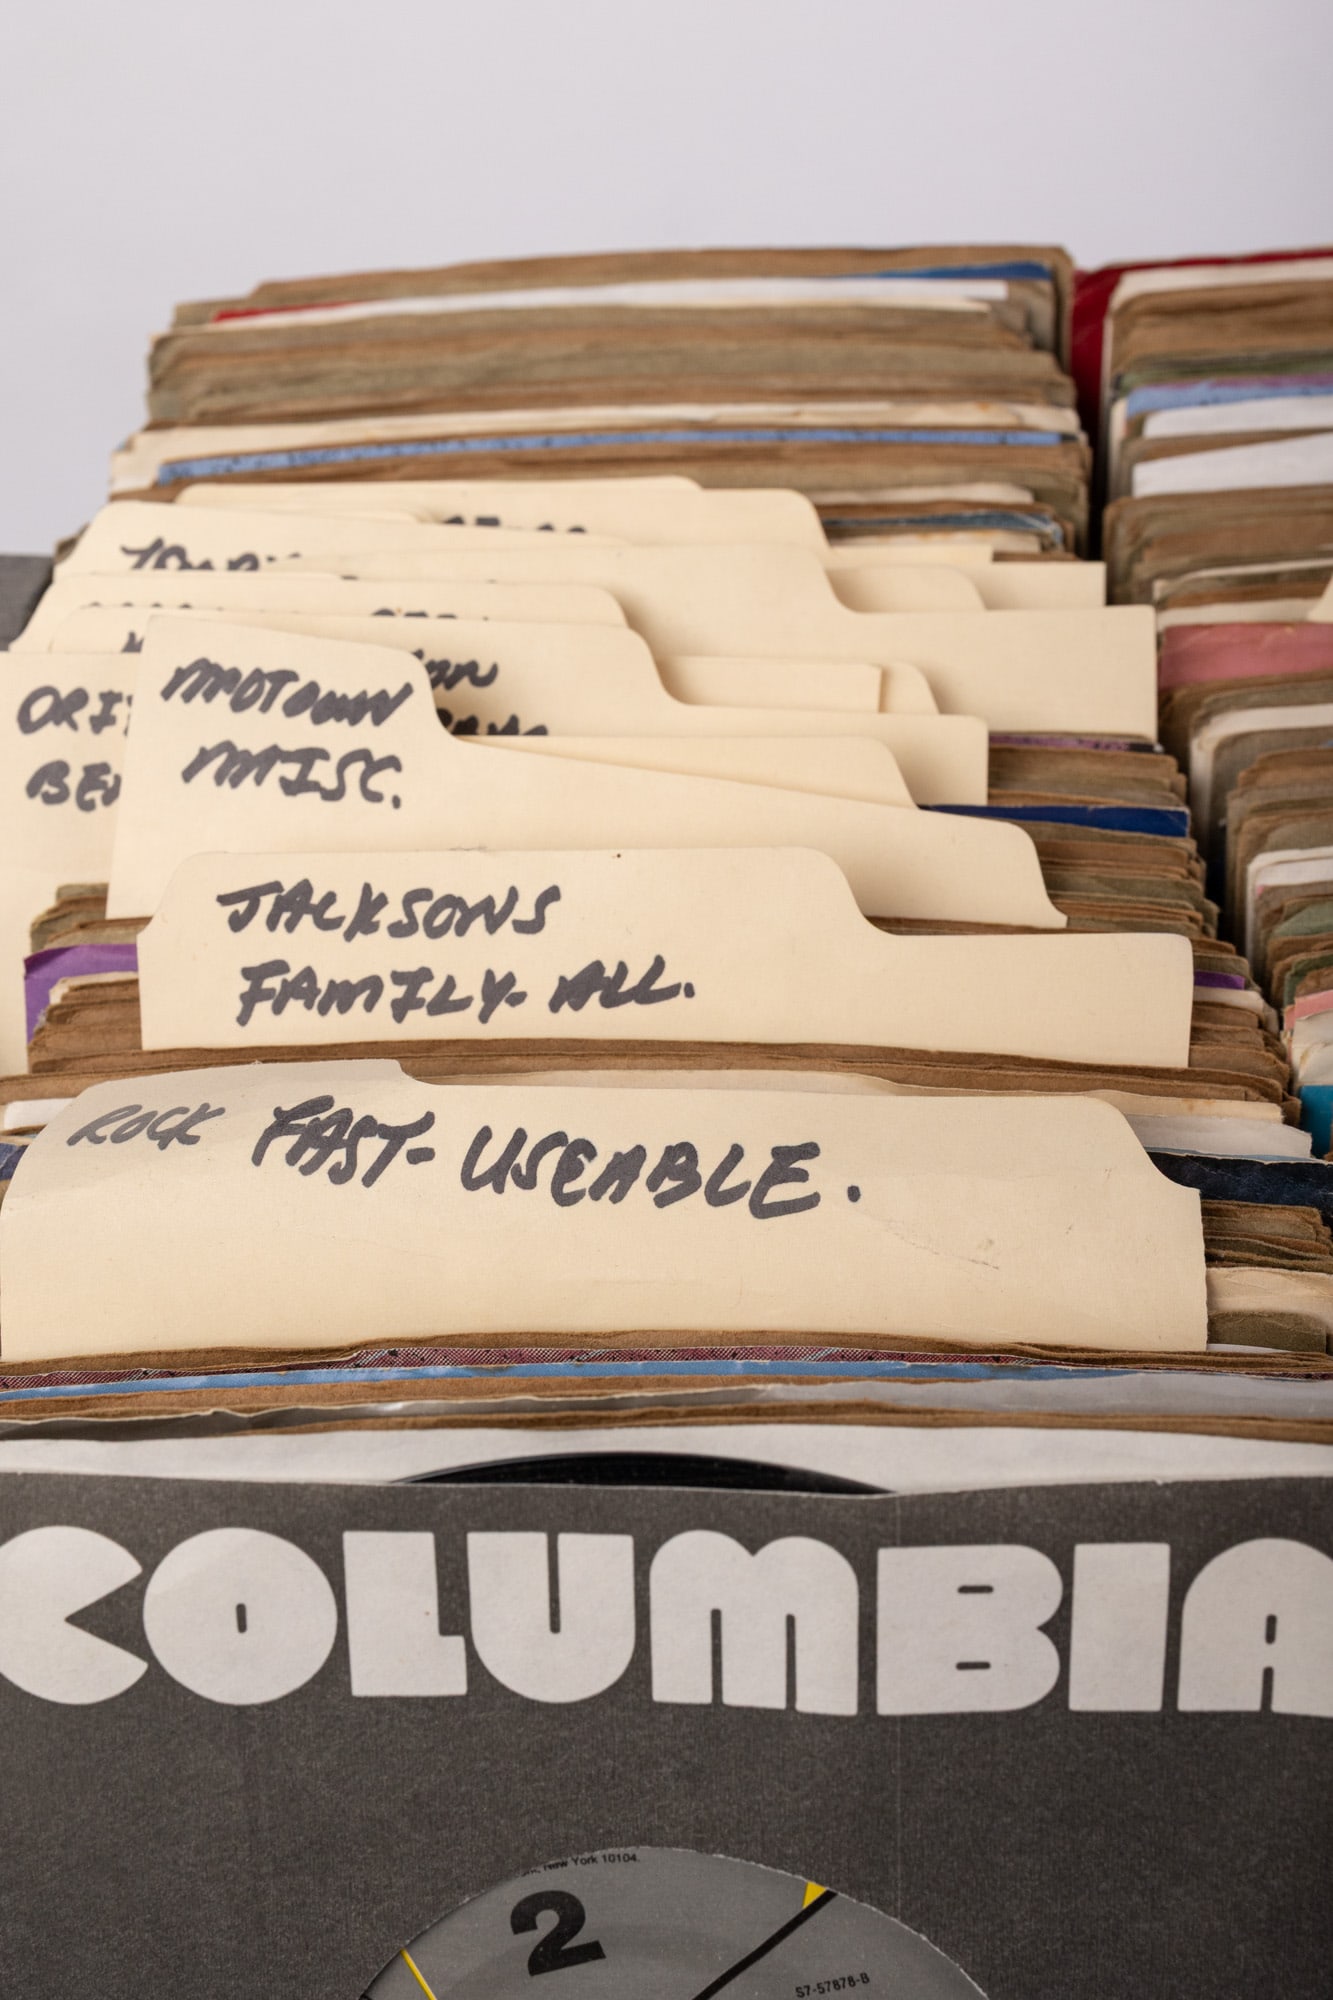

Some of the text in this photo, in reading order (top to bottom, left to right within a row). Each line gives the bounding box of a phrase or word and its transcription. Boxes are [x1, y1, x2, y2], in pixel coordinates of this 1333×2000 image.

[16, 685, 133, 736] ORI
[160, 656, 414, 726] MOTOWN
[181, 740, 403, 810] MISC.
[216, 879, 562, 942] JACKSONS
[547, 954, 697, 1013] ALL.
[66, 1102, 226, 1153] ROCK
[250, 1094, 436, 1189] FAST-
[0, 1524, 1333, 1718] COLUMBIA
[571, 1855, 598, 1866] York
[509, 1889, 608, 1977] 2
